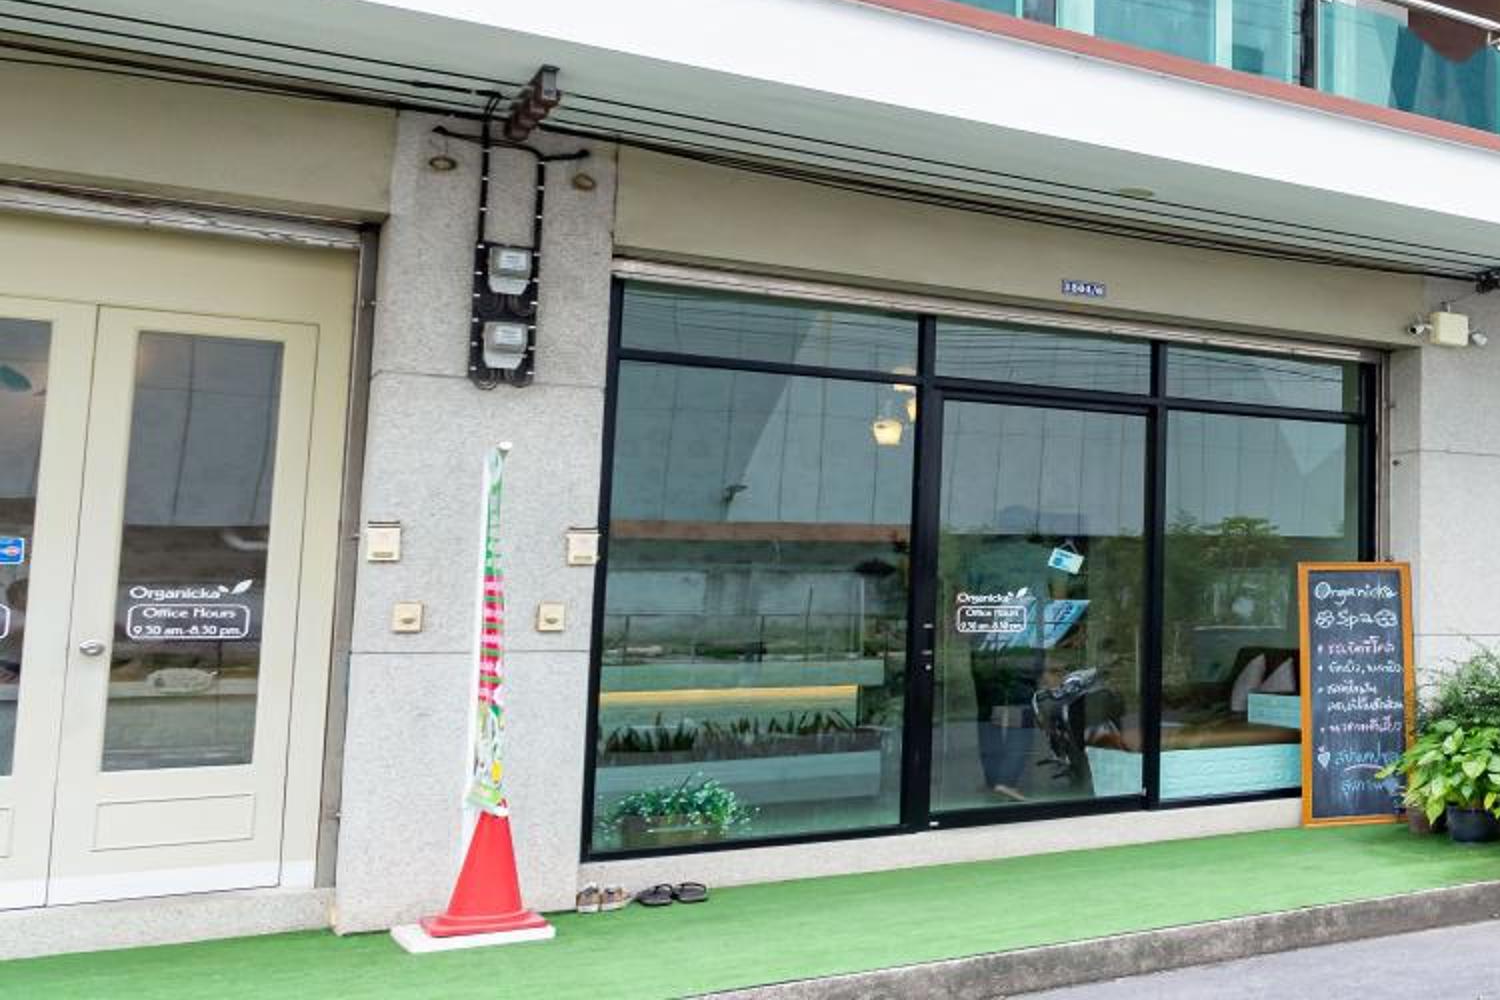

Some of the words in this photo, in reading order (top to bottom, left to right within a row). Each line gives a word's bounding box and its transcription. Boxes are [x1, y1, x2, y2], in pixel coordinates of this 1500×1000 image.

[129, 585, 221, 601] Organicka
[142, 607, 189, 618] Office
[193, 607, 237, 619] Hours
[1336, 607, 1375, 630] Spa
